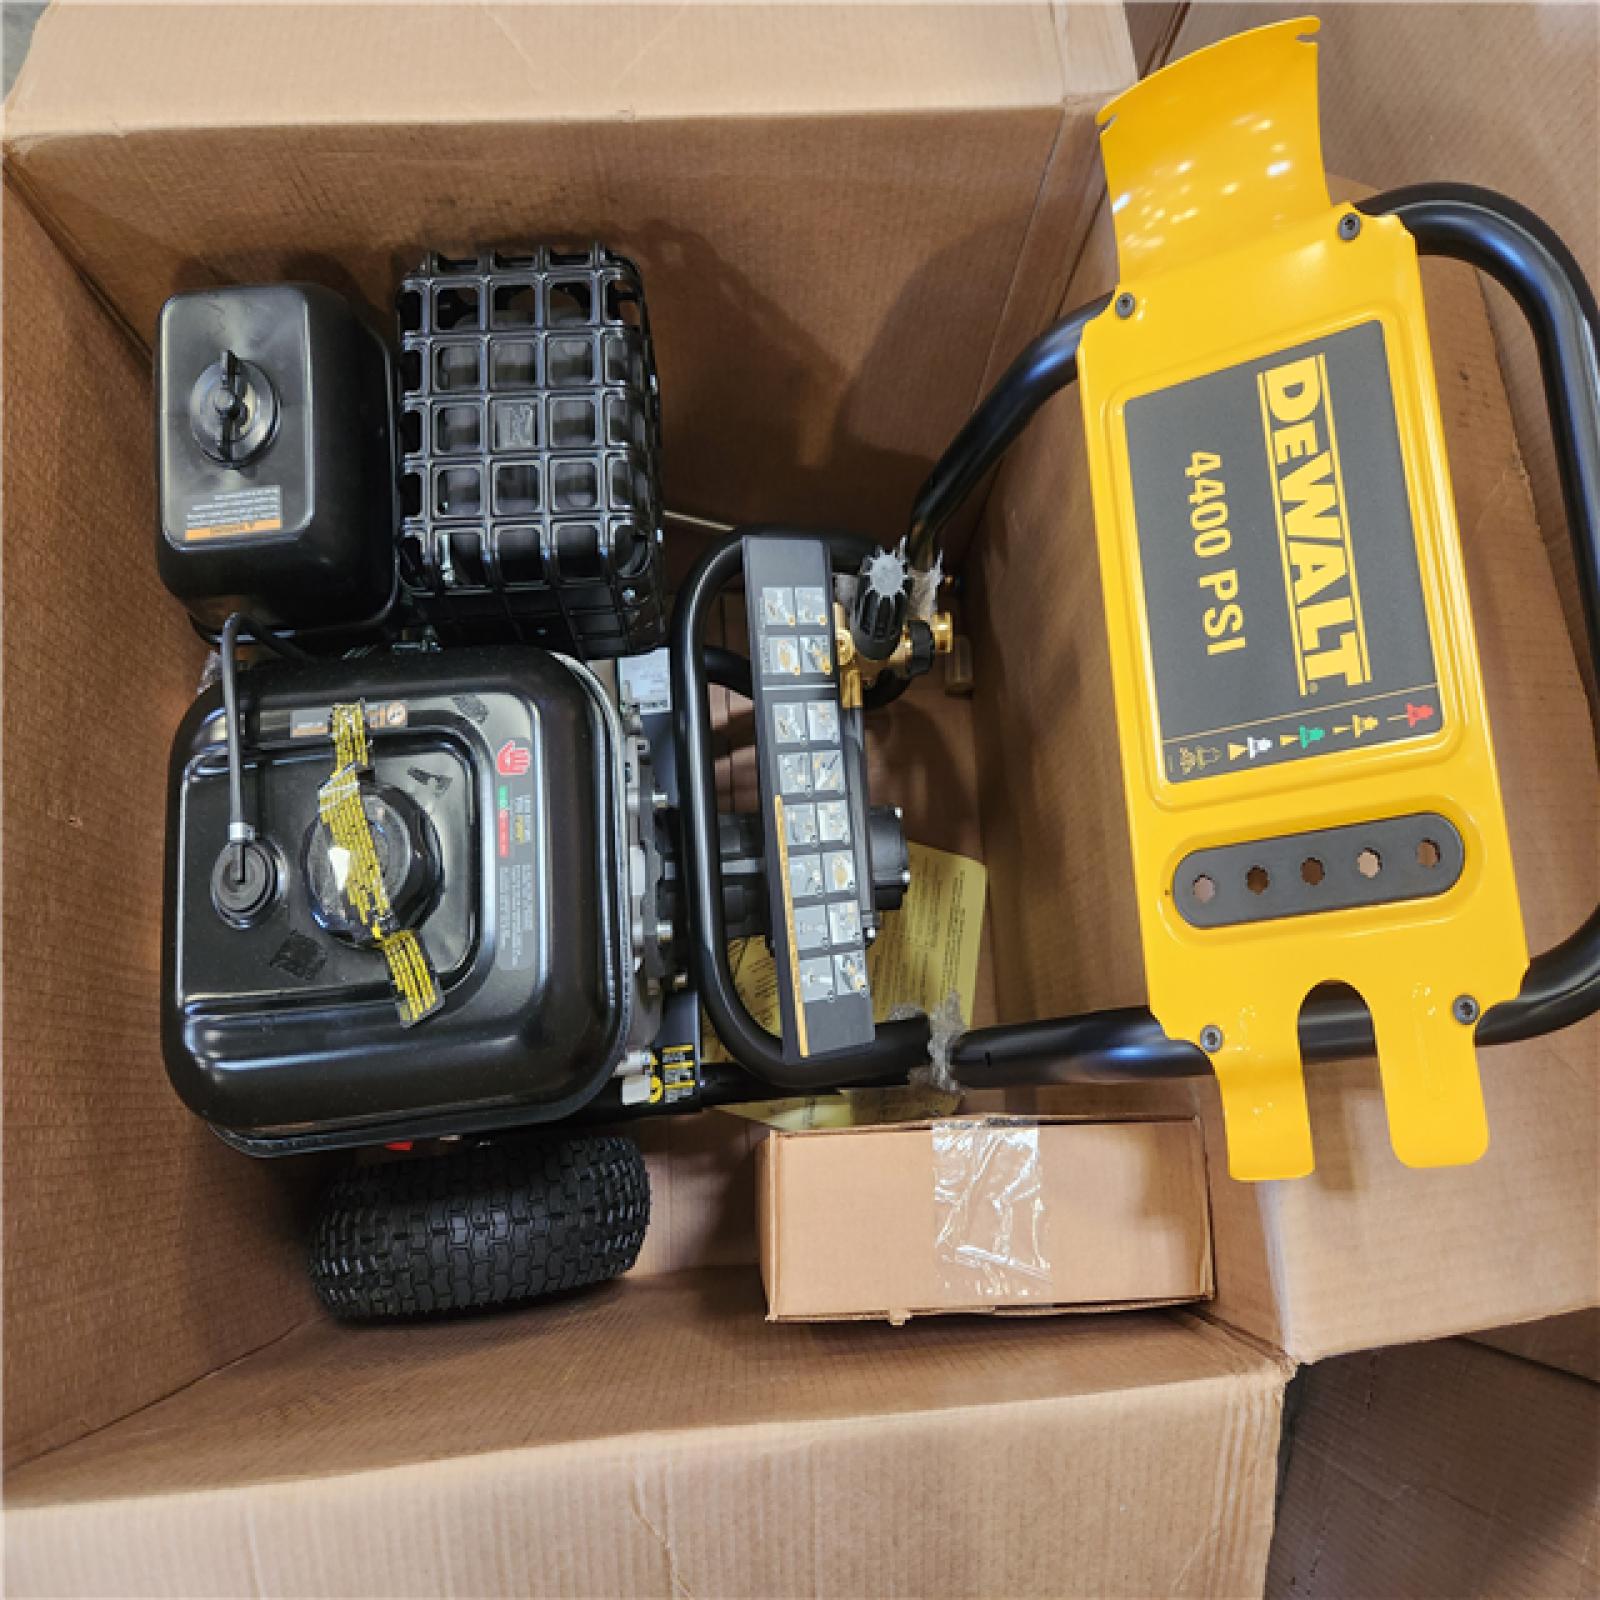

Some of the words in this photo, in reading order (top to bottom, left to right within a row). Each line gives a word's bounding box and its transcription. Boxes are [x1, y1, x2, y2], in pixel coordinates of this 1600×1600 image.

[1185, 451, 1232, 557] 4400
[1263, 355, 1365, 687] DEWALT
[1199, 569, 1246, 655] PSI
